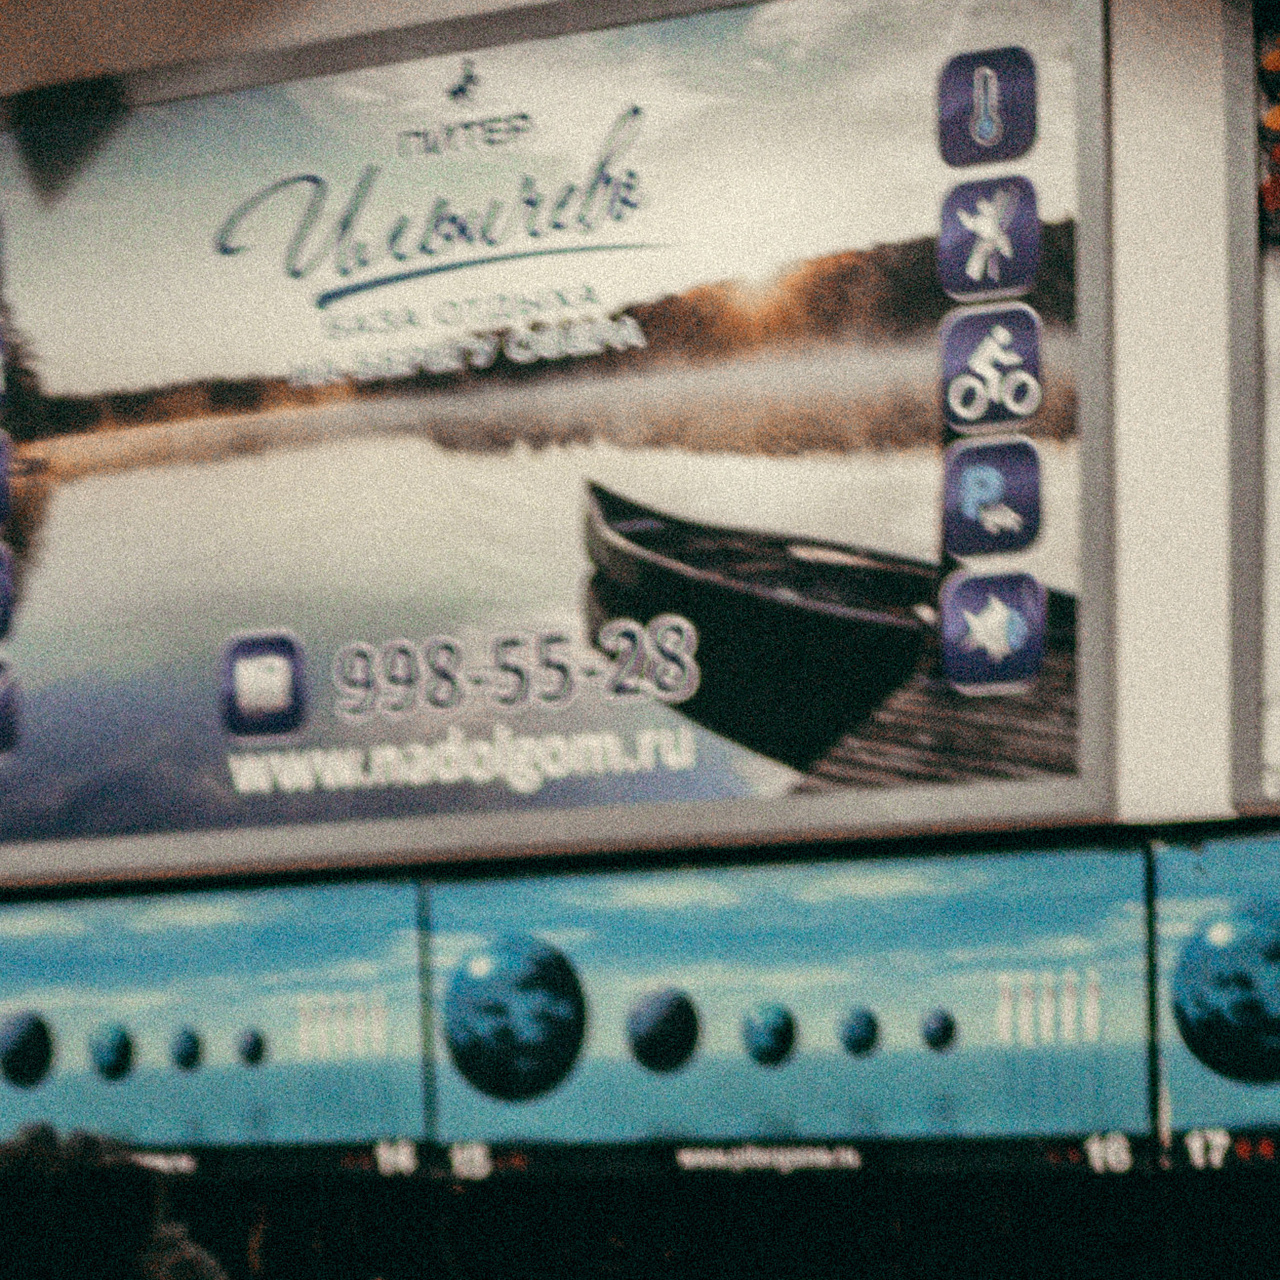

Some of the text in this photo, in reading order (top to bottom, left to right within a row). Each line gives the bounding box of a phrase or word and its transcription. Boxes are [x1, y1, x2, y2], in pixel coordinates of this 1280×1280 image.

[334, 613, 701, 722] 998-55-28
[227, 724, 696, 795] www.nadolgom.ru
[1184, 1127, 1232, 1170] 17
